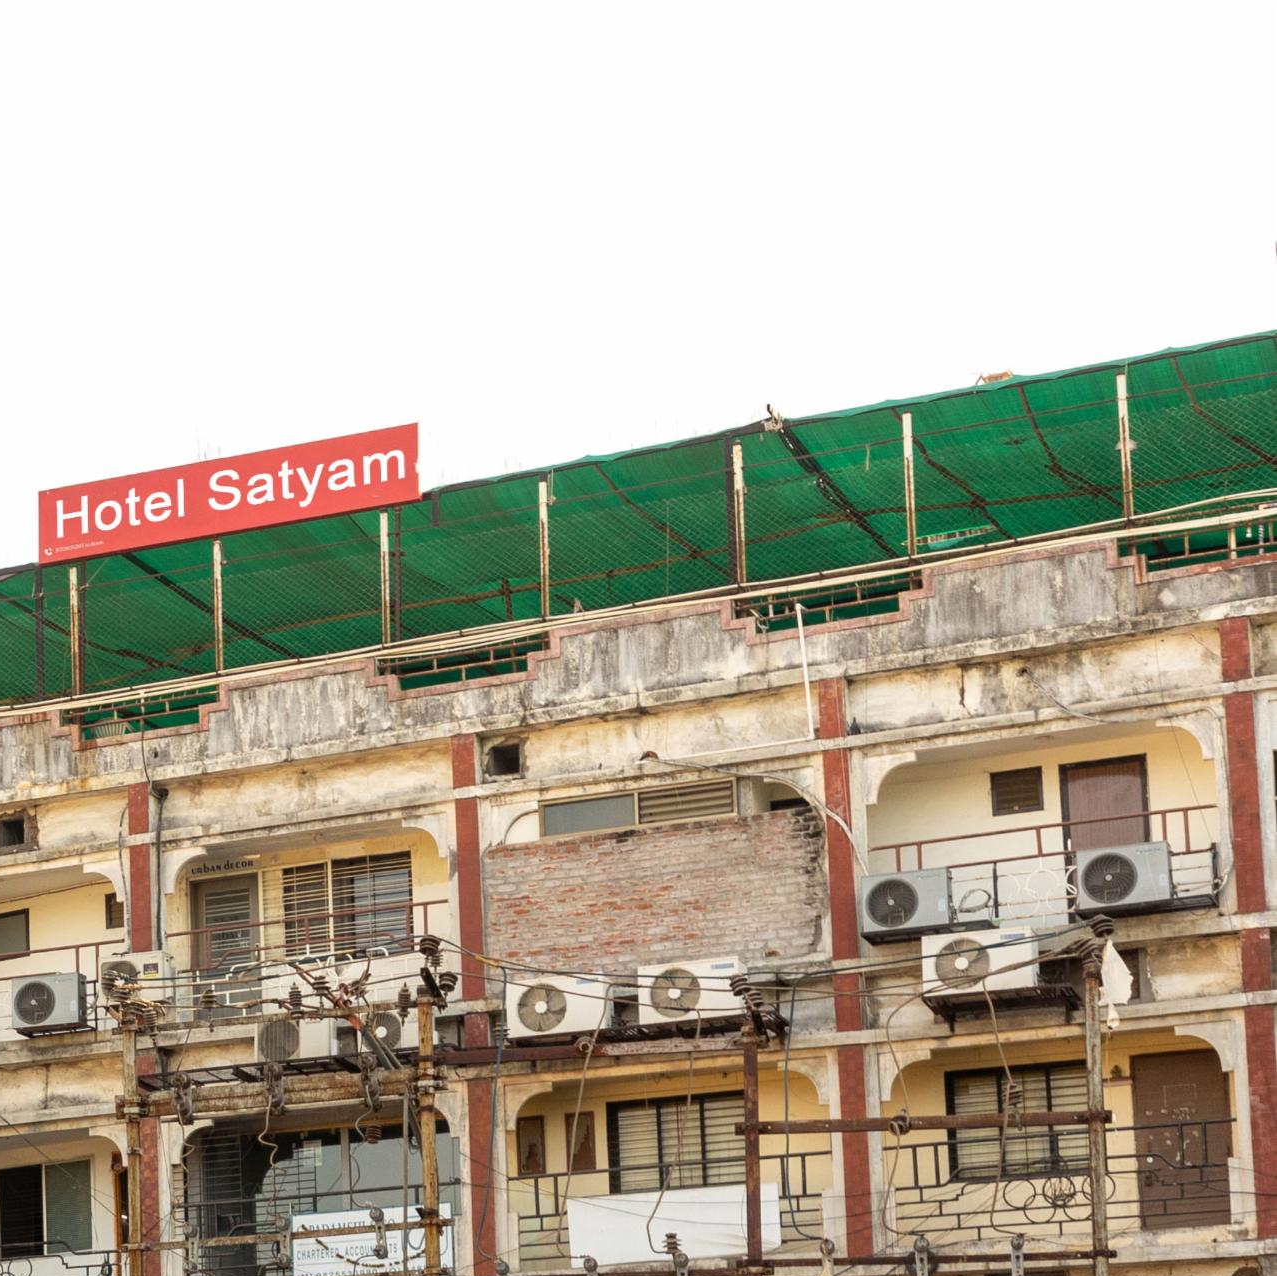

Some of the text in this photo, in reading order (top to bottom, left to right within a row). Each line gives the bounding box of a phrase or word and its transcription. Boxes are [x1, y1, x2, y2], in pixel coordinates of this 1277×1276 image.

[55, 448, 406, 540] Hotel Satyam
[344, 1243, 398, 1257] ACCOUNTS
